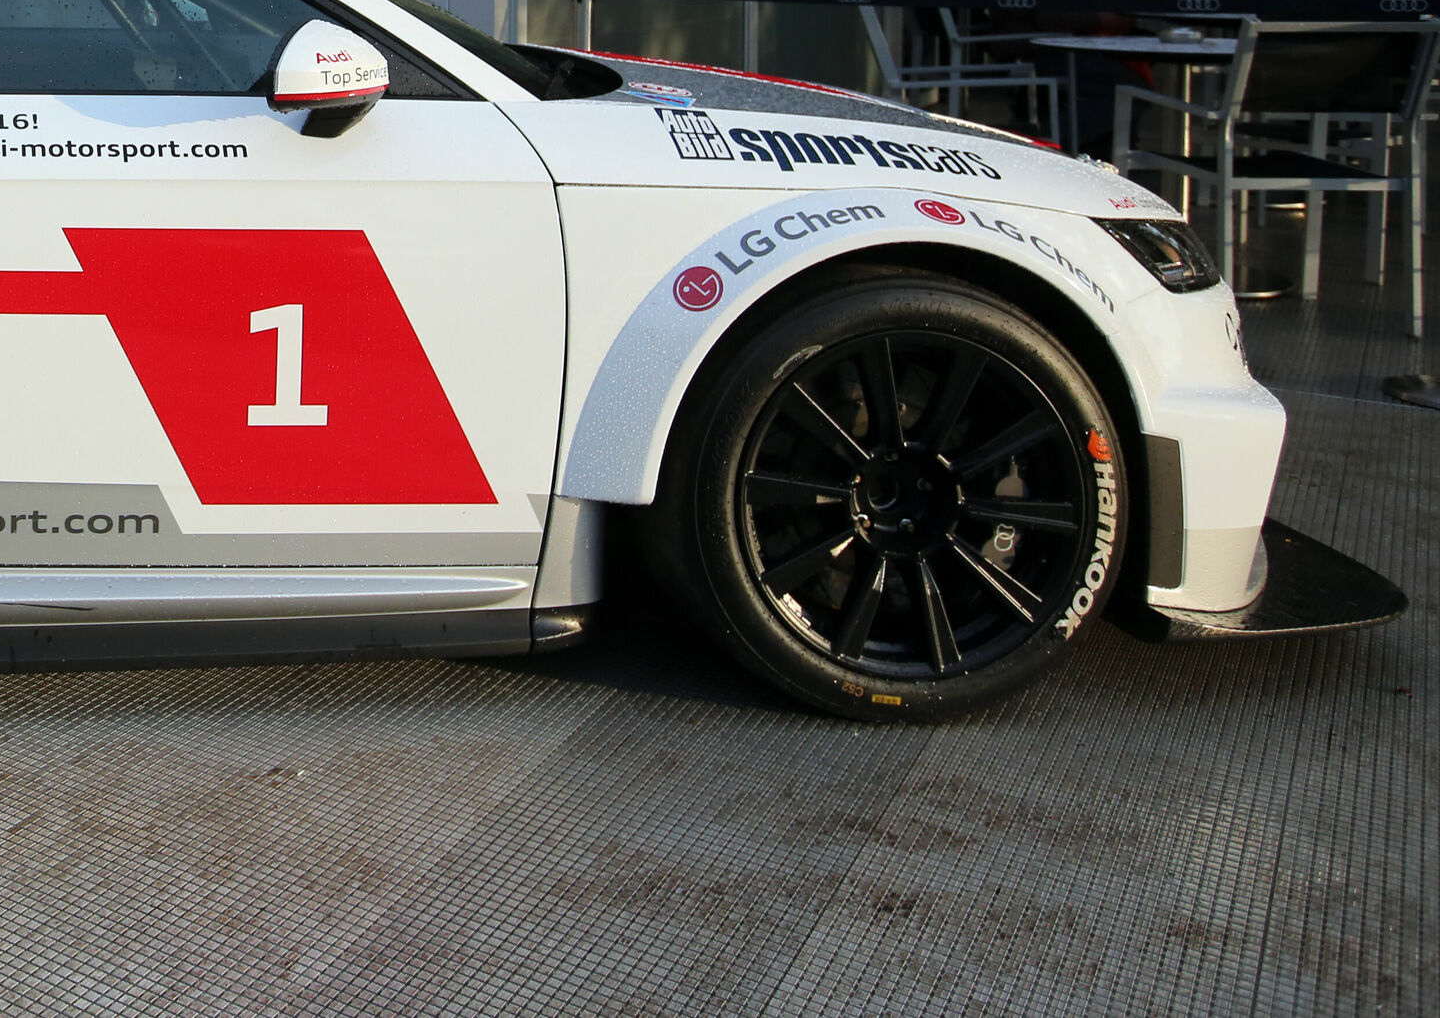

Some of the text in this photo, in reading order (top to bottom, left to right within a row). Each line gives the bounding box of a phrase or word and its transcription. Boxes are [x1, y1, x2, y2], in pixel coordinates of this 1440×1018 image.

[315, 49, 353, 64] Audi
[320, 65, 388, 88] Top Service
[714, 229, 777, 276] LG
[773, 204, 886, 241] Chem
[968, 210, 1026, 244] LG
[1029, 235, 1115, 314] Chem
[247, 303, 329, 427] 1
